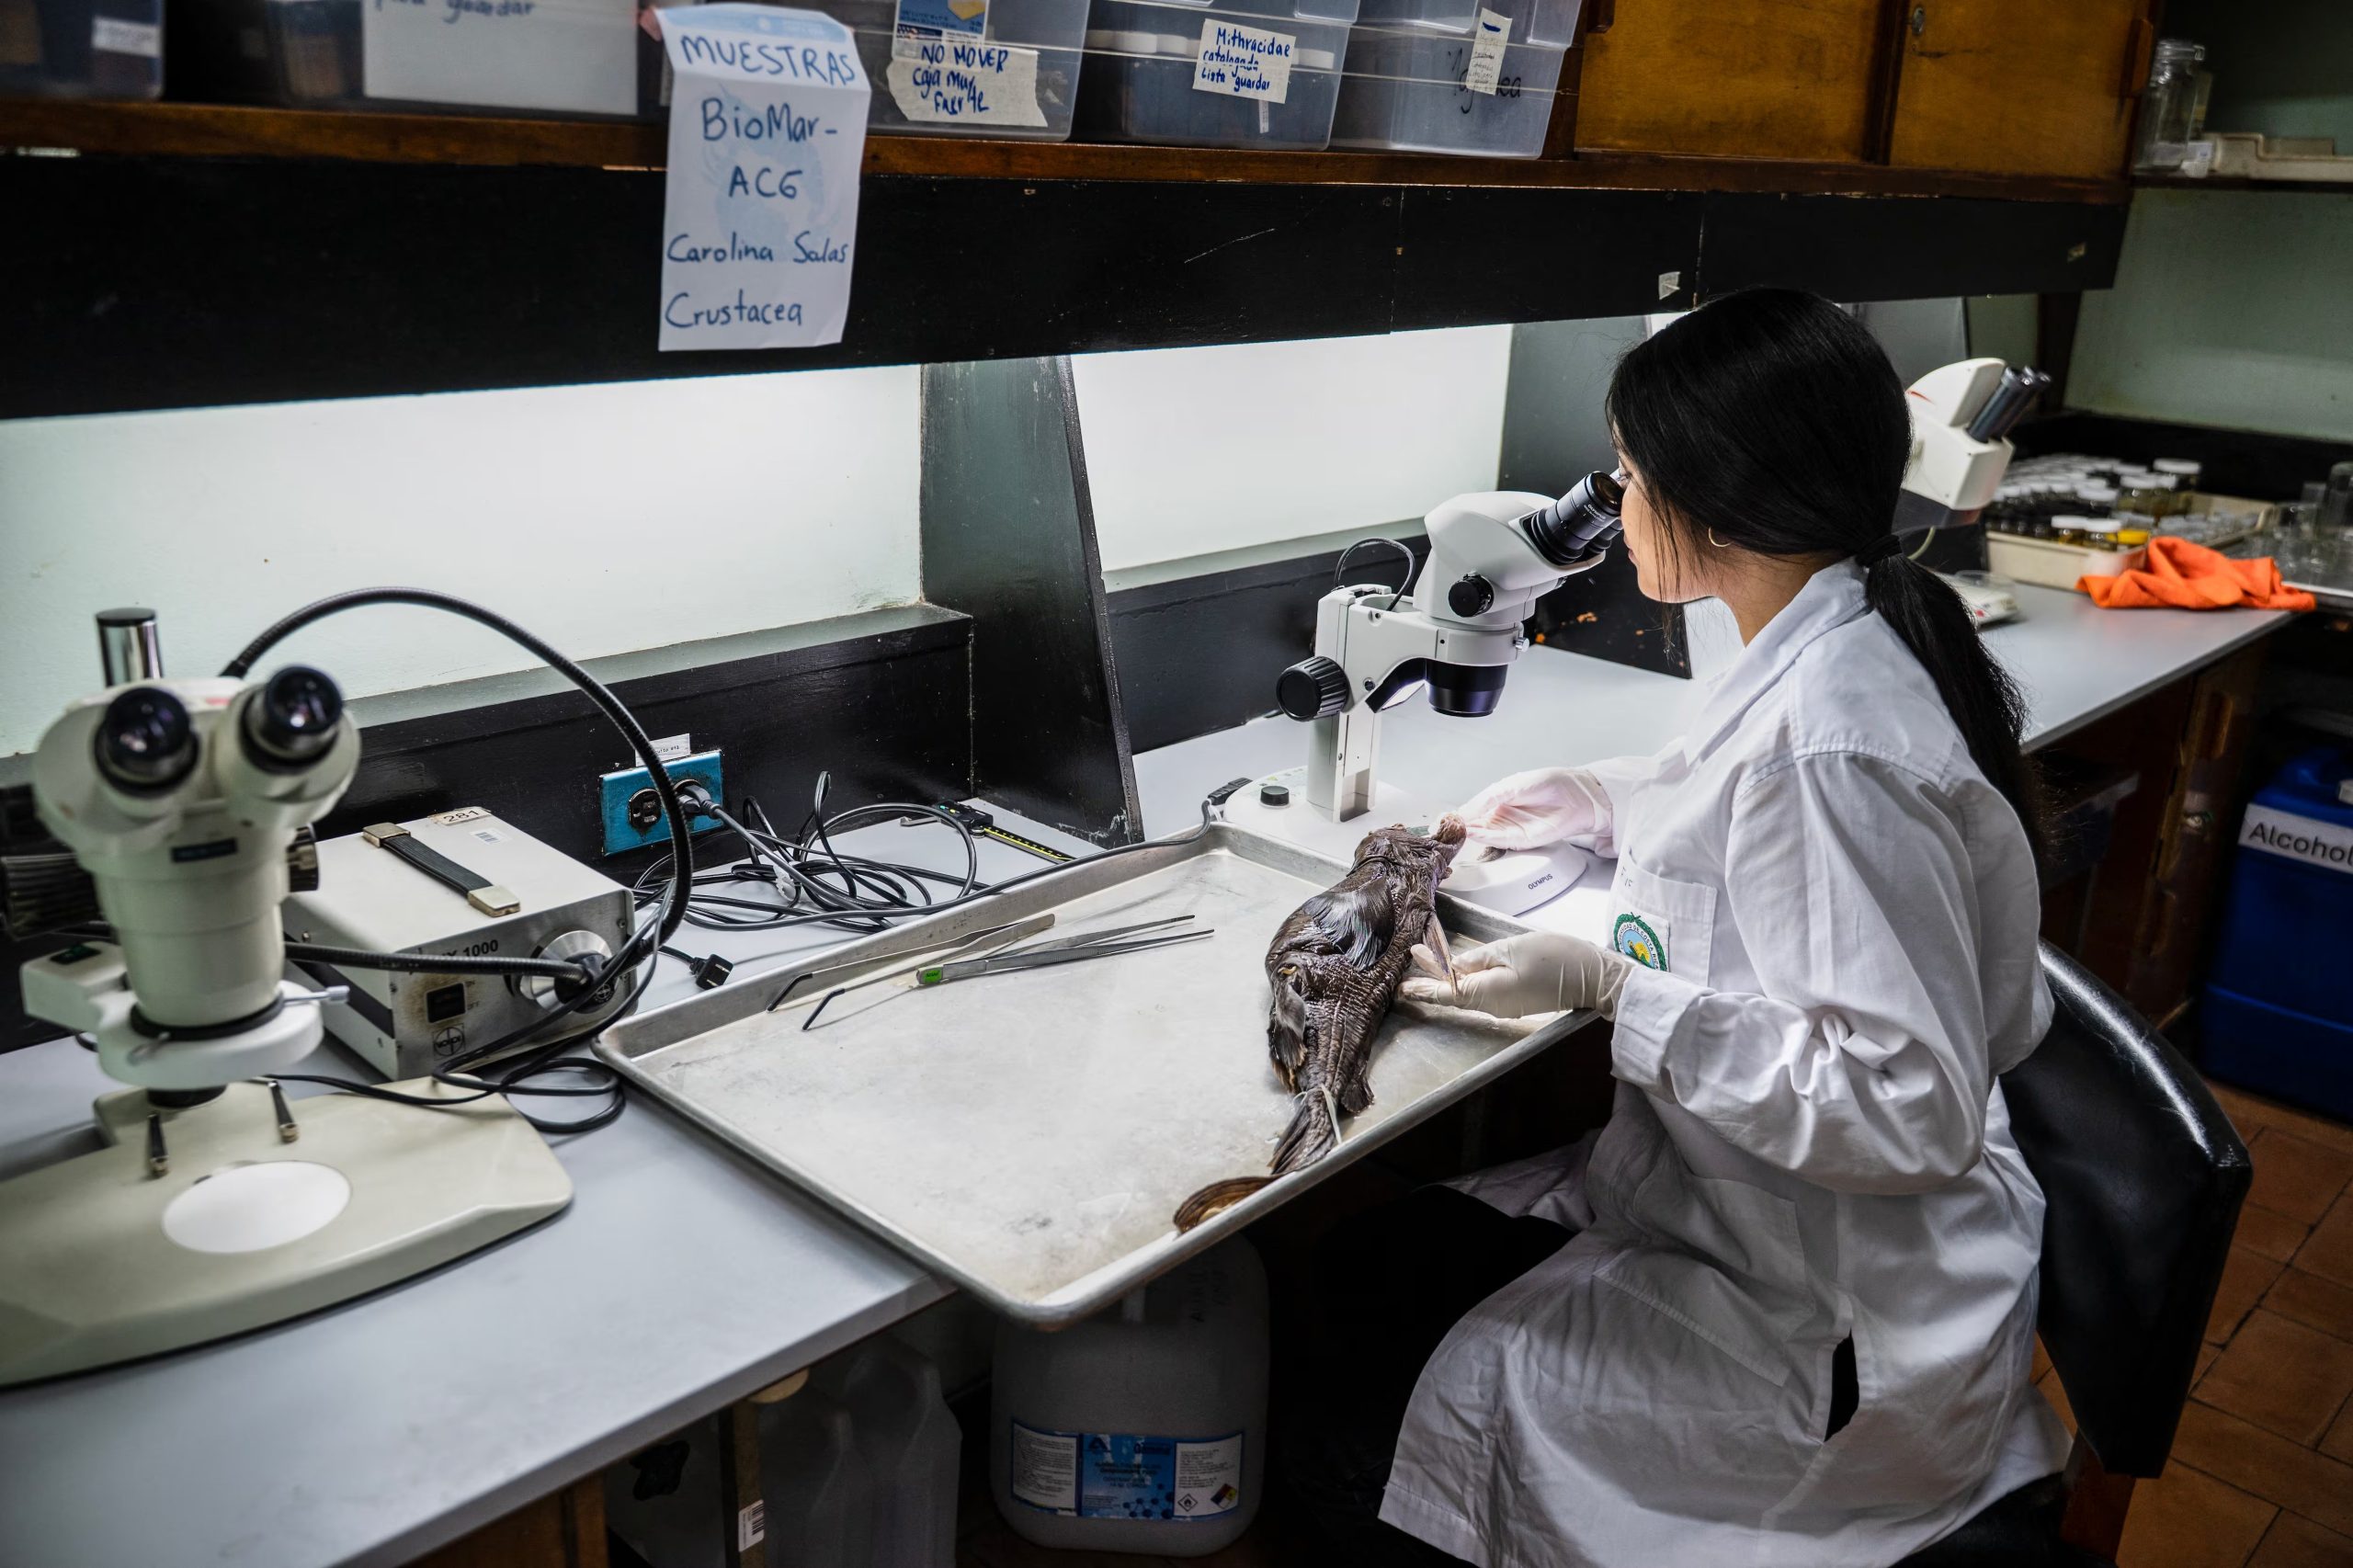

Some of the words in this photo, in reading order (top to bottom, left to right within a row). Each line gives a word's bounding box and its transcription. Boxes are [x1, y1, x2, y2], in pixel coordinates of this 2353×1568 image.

[1216, 27, 1290, 57] Mithracidae
[680, 35, 856, 85] MUESTRAS
[921, 43, 945, 64] NO
[953, 44, 1009, 74] MOVER
[666, 232, 774, 263] Carolina
[792, 232, 849, 264] Salas
[665, 290, 802, 328] Crustacea
[443, 810, 480, 823] 281
[1528, 873, 1553, 890] OLYMPUS
[462, 939, 498, 957] 1000
